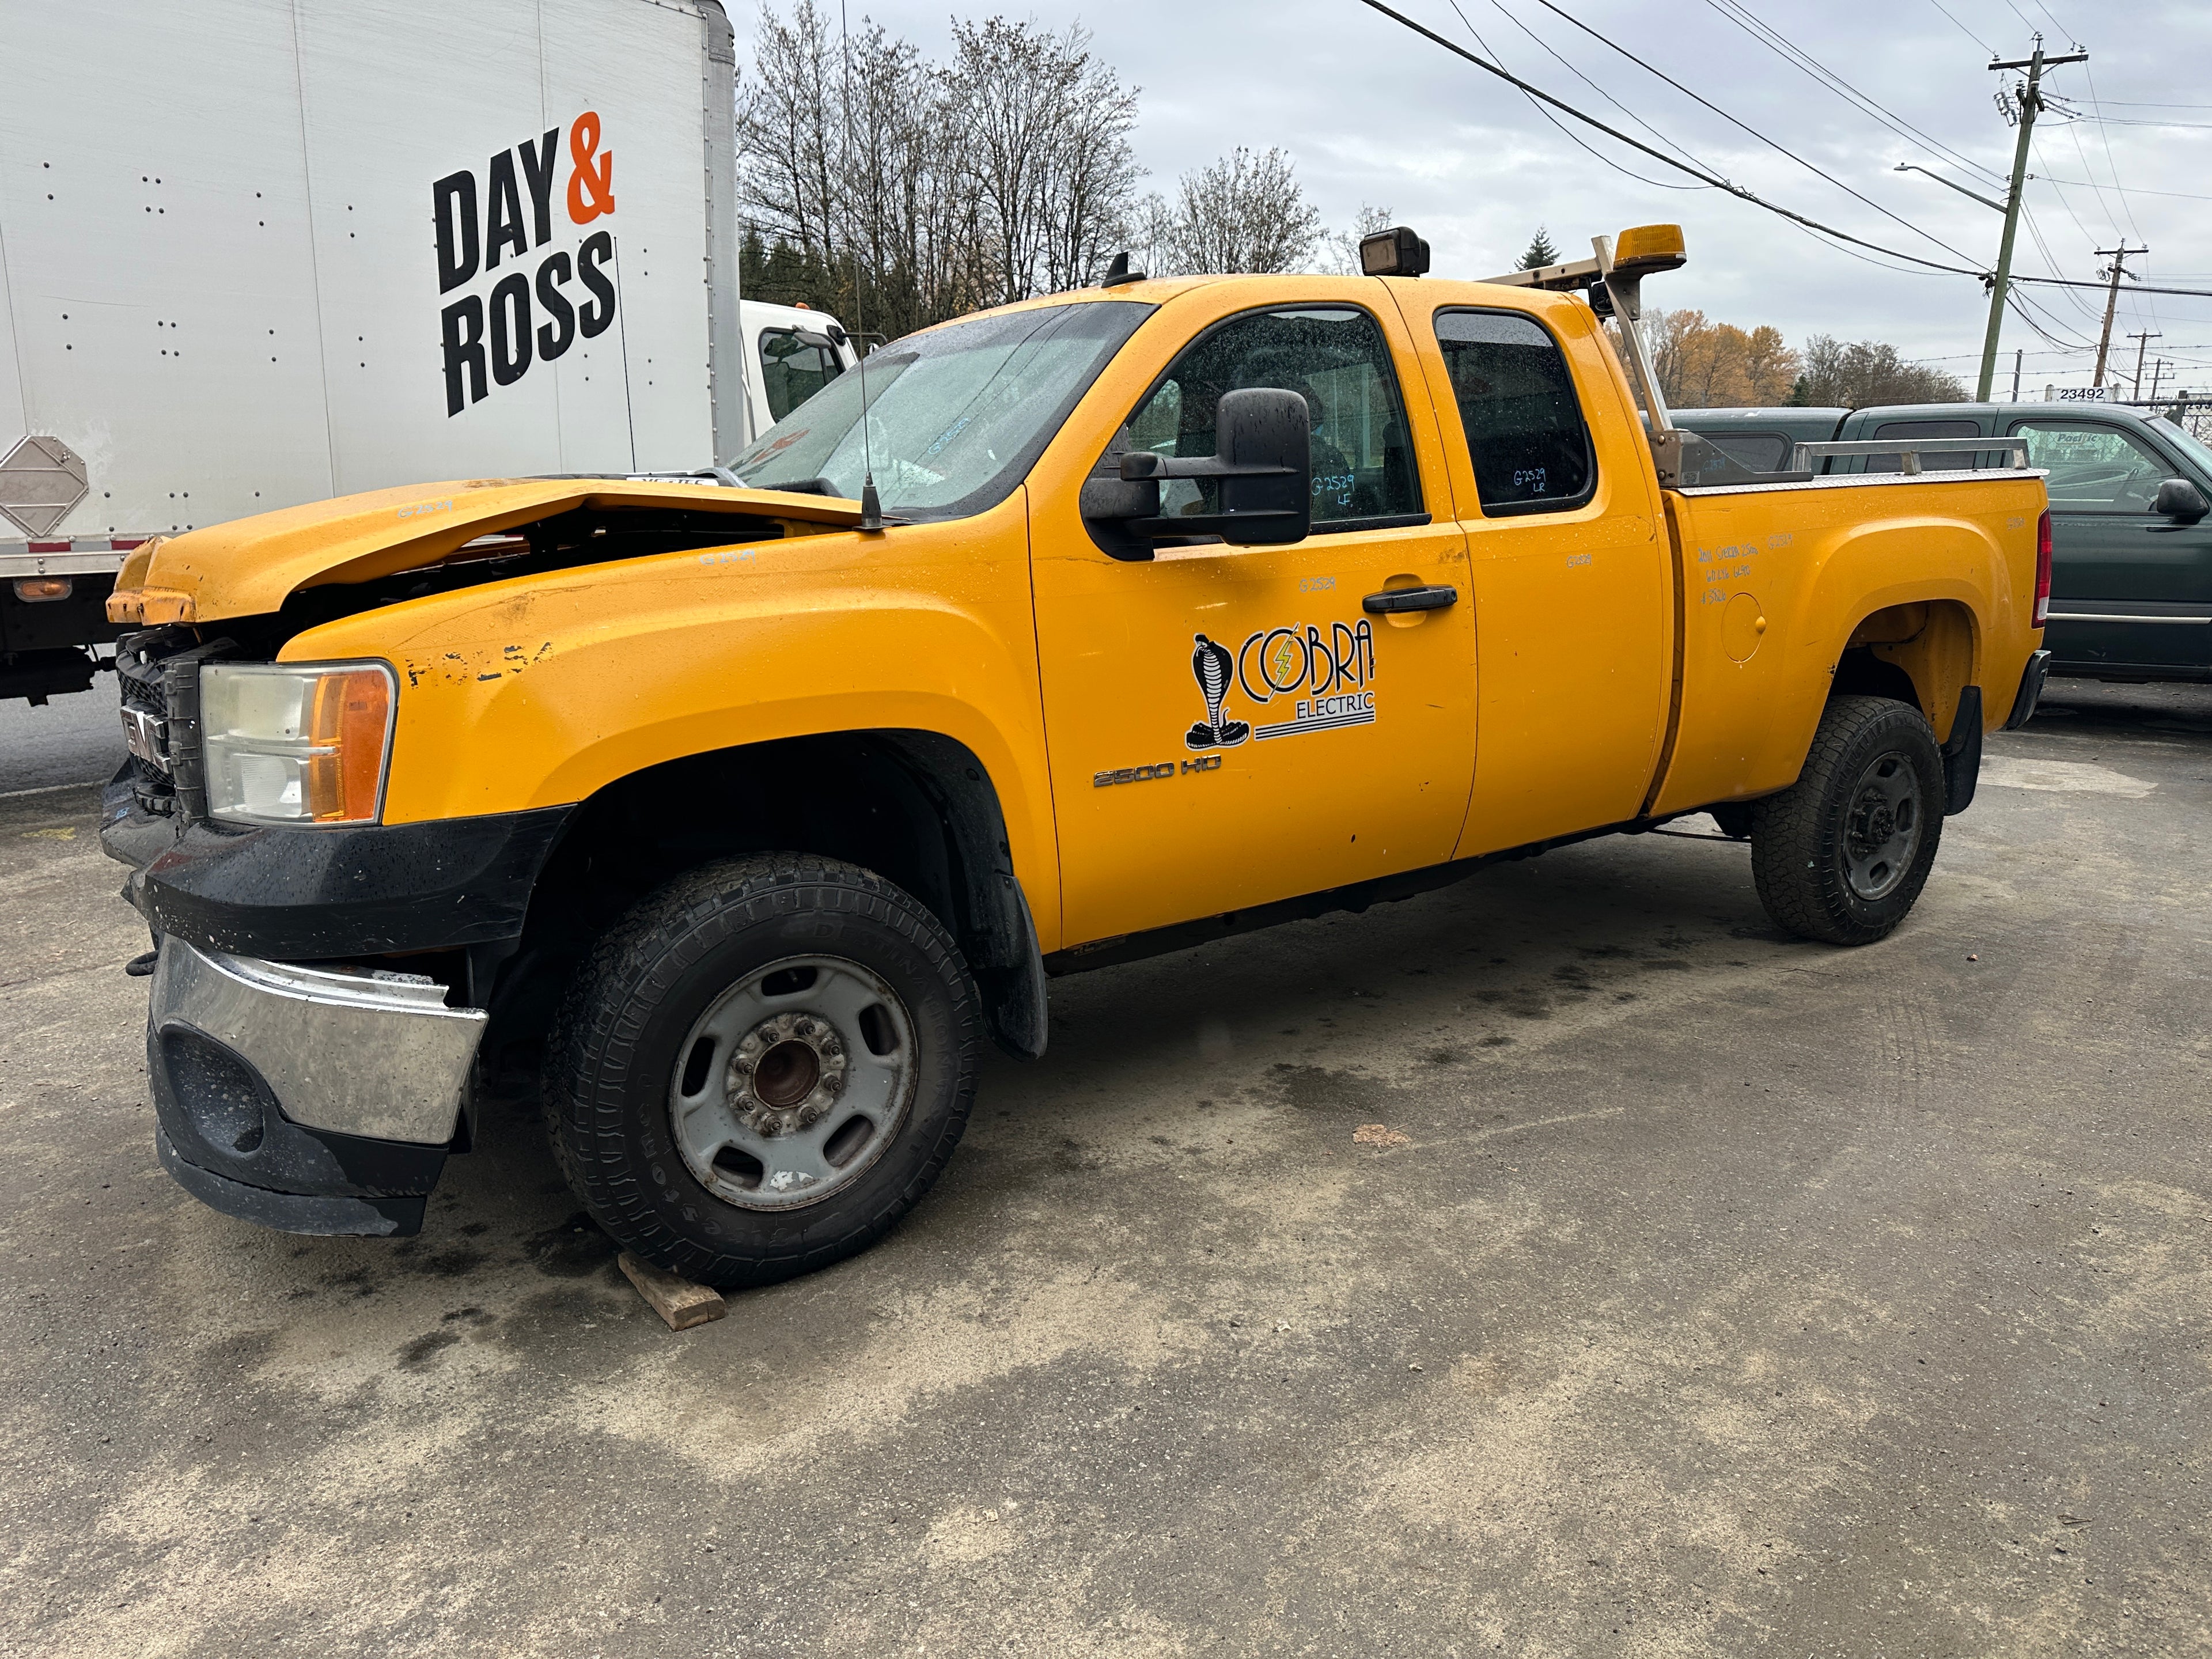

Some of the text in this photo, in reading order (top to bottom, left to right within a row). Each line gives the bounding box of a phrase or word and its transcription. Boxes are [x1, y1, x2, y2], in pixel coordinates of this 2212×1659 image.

[433, 111, 615, 296] DAY &
[441, 230, 615, 418] ROSS
[2061, 388, 2104, 399] 23492
[1312, 474, 1354, 495] G2529
[1514, 468, 1546, 486] G2529
[1533, 482, 1545, 493] LR
[397, 499, 453, 518] G2529
[1300, 576, 1336, 593] G2529
[1239, 619, 1374, 702] COBRA
[1297, 692, 1374, 719] ELECTRIC
[1094, 753, 1222, 787] 2500 HD
[812, 919, 953, 1071] DESTINATION
